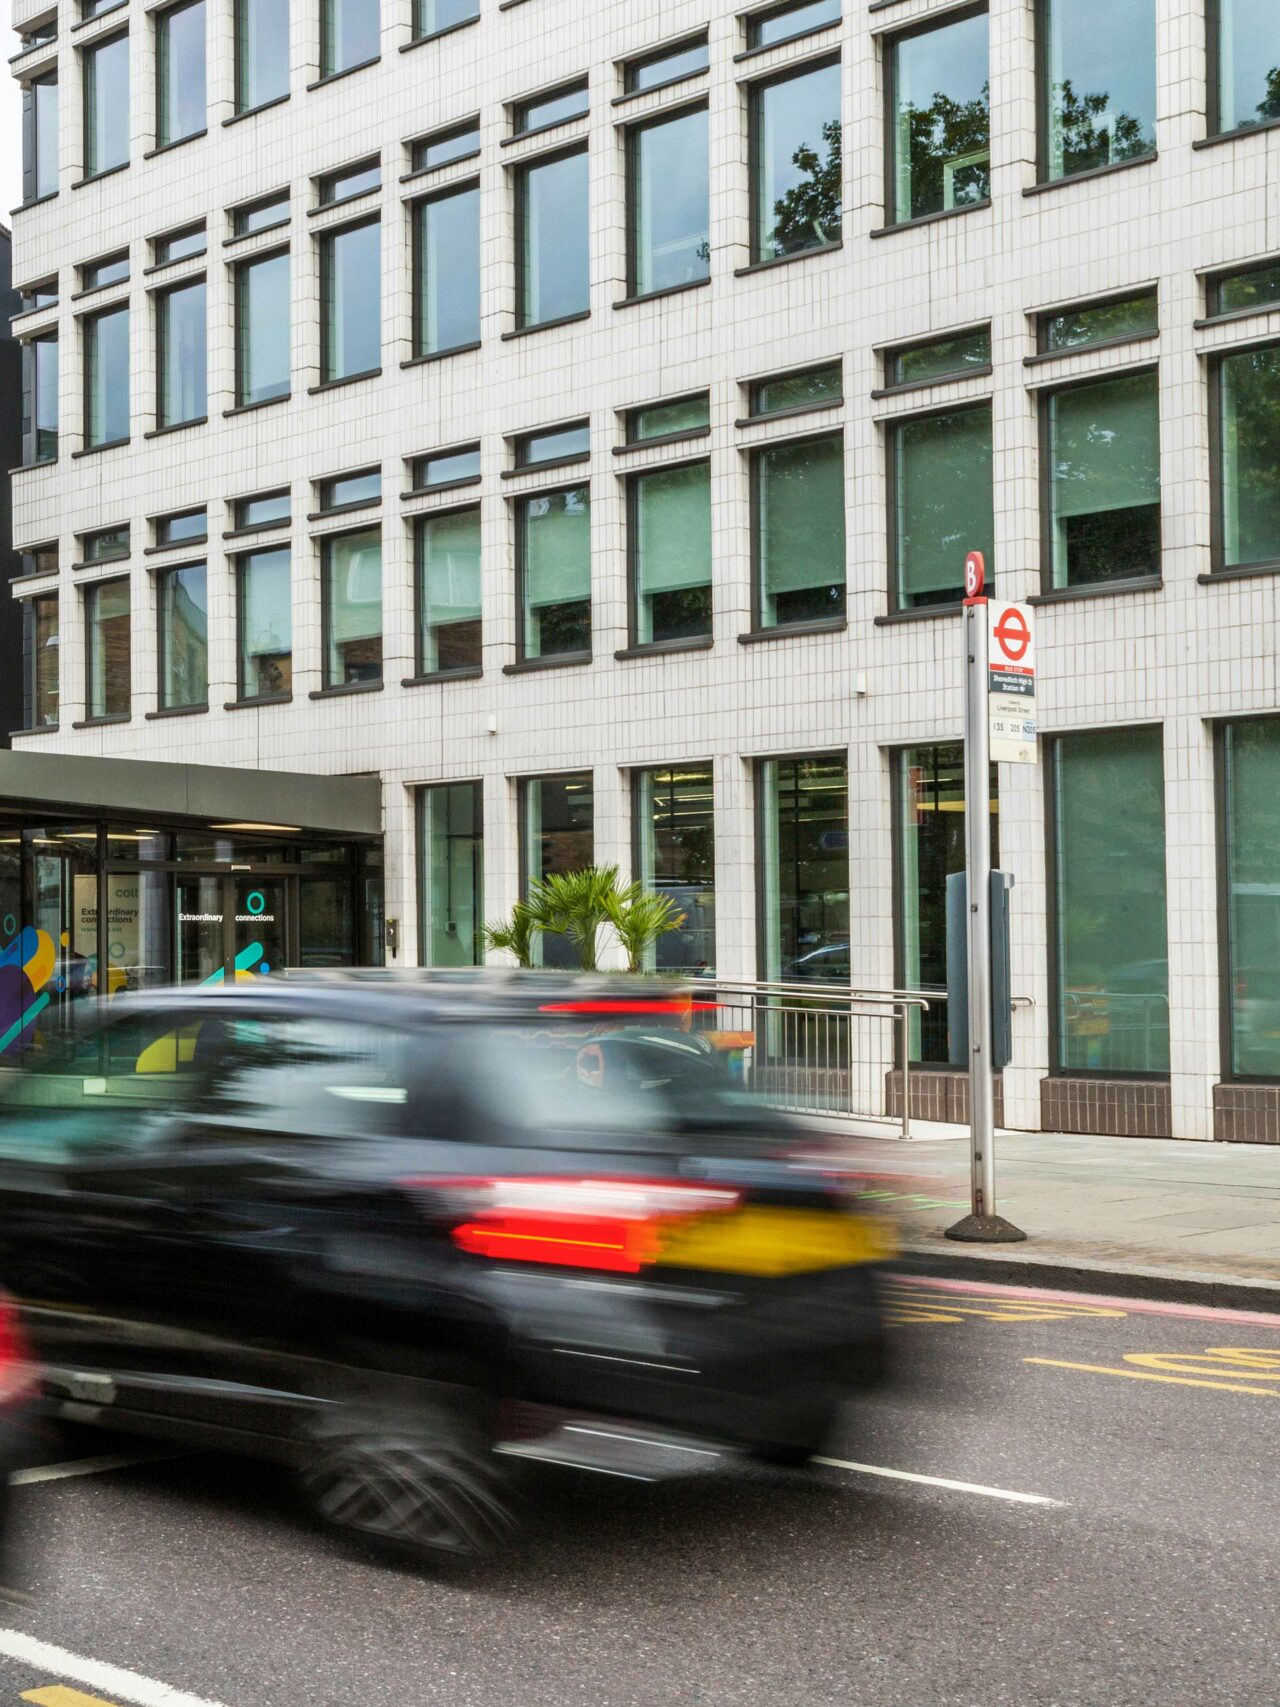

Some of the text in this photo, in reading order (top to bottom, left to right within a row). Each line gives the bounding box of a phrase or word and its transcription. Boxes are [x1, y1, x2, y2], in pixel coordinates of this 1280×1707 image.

[967, 559, 977, 593] B
[997, 704, 1017, 713] Liverpool
[81, 908, 139, 917] Extrrdinary
[178, 913, 275, 922] Extraordinary connections
